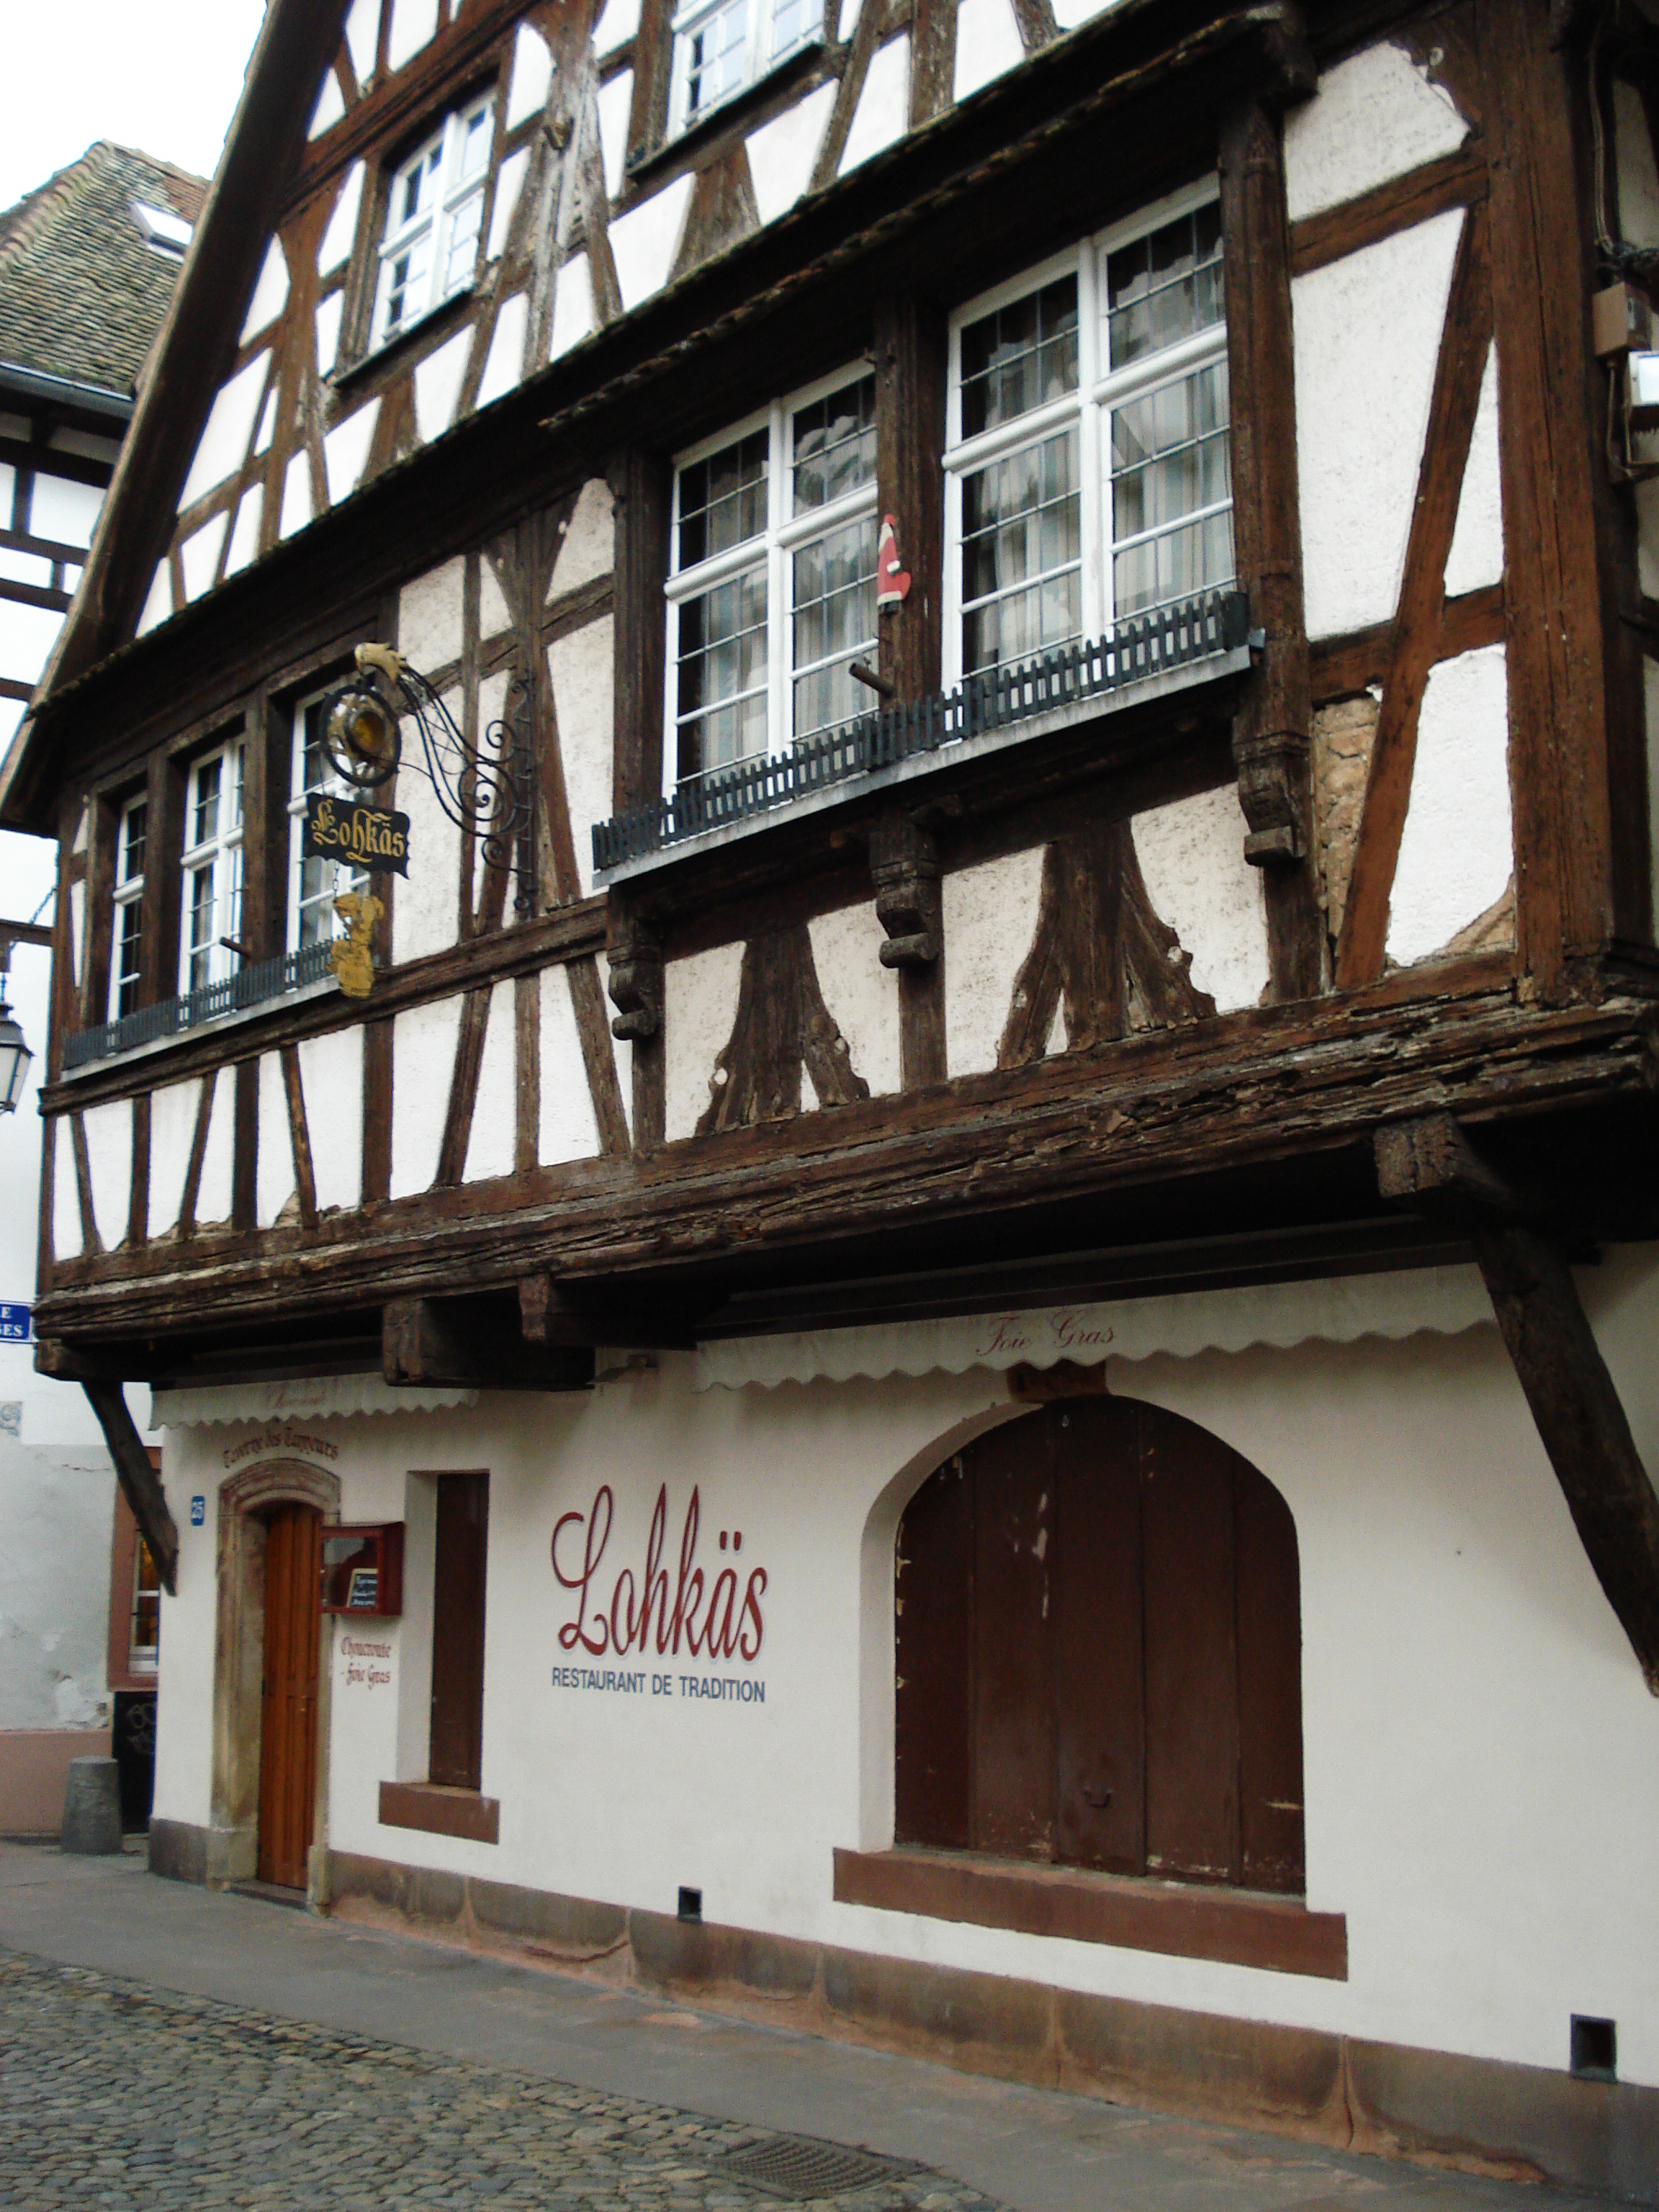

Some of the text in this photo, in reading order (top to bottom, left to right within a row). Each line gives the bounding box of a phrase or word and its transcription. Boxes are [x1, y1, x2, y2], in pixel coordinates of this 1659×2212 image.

[311, 799, 405, 863] Lohkäs
[551, 1483, 768, 1662] Lohkäs
[552, 1667, 765, 1703] RESTAURANT DE TRADITION
